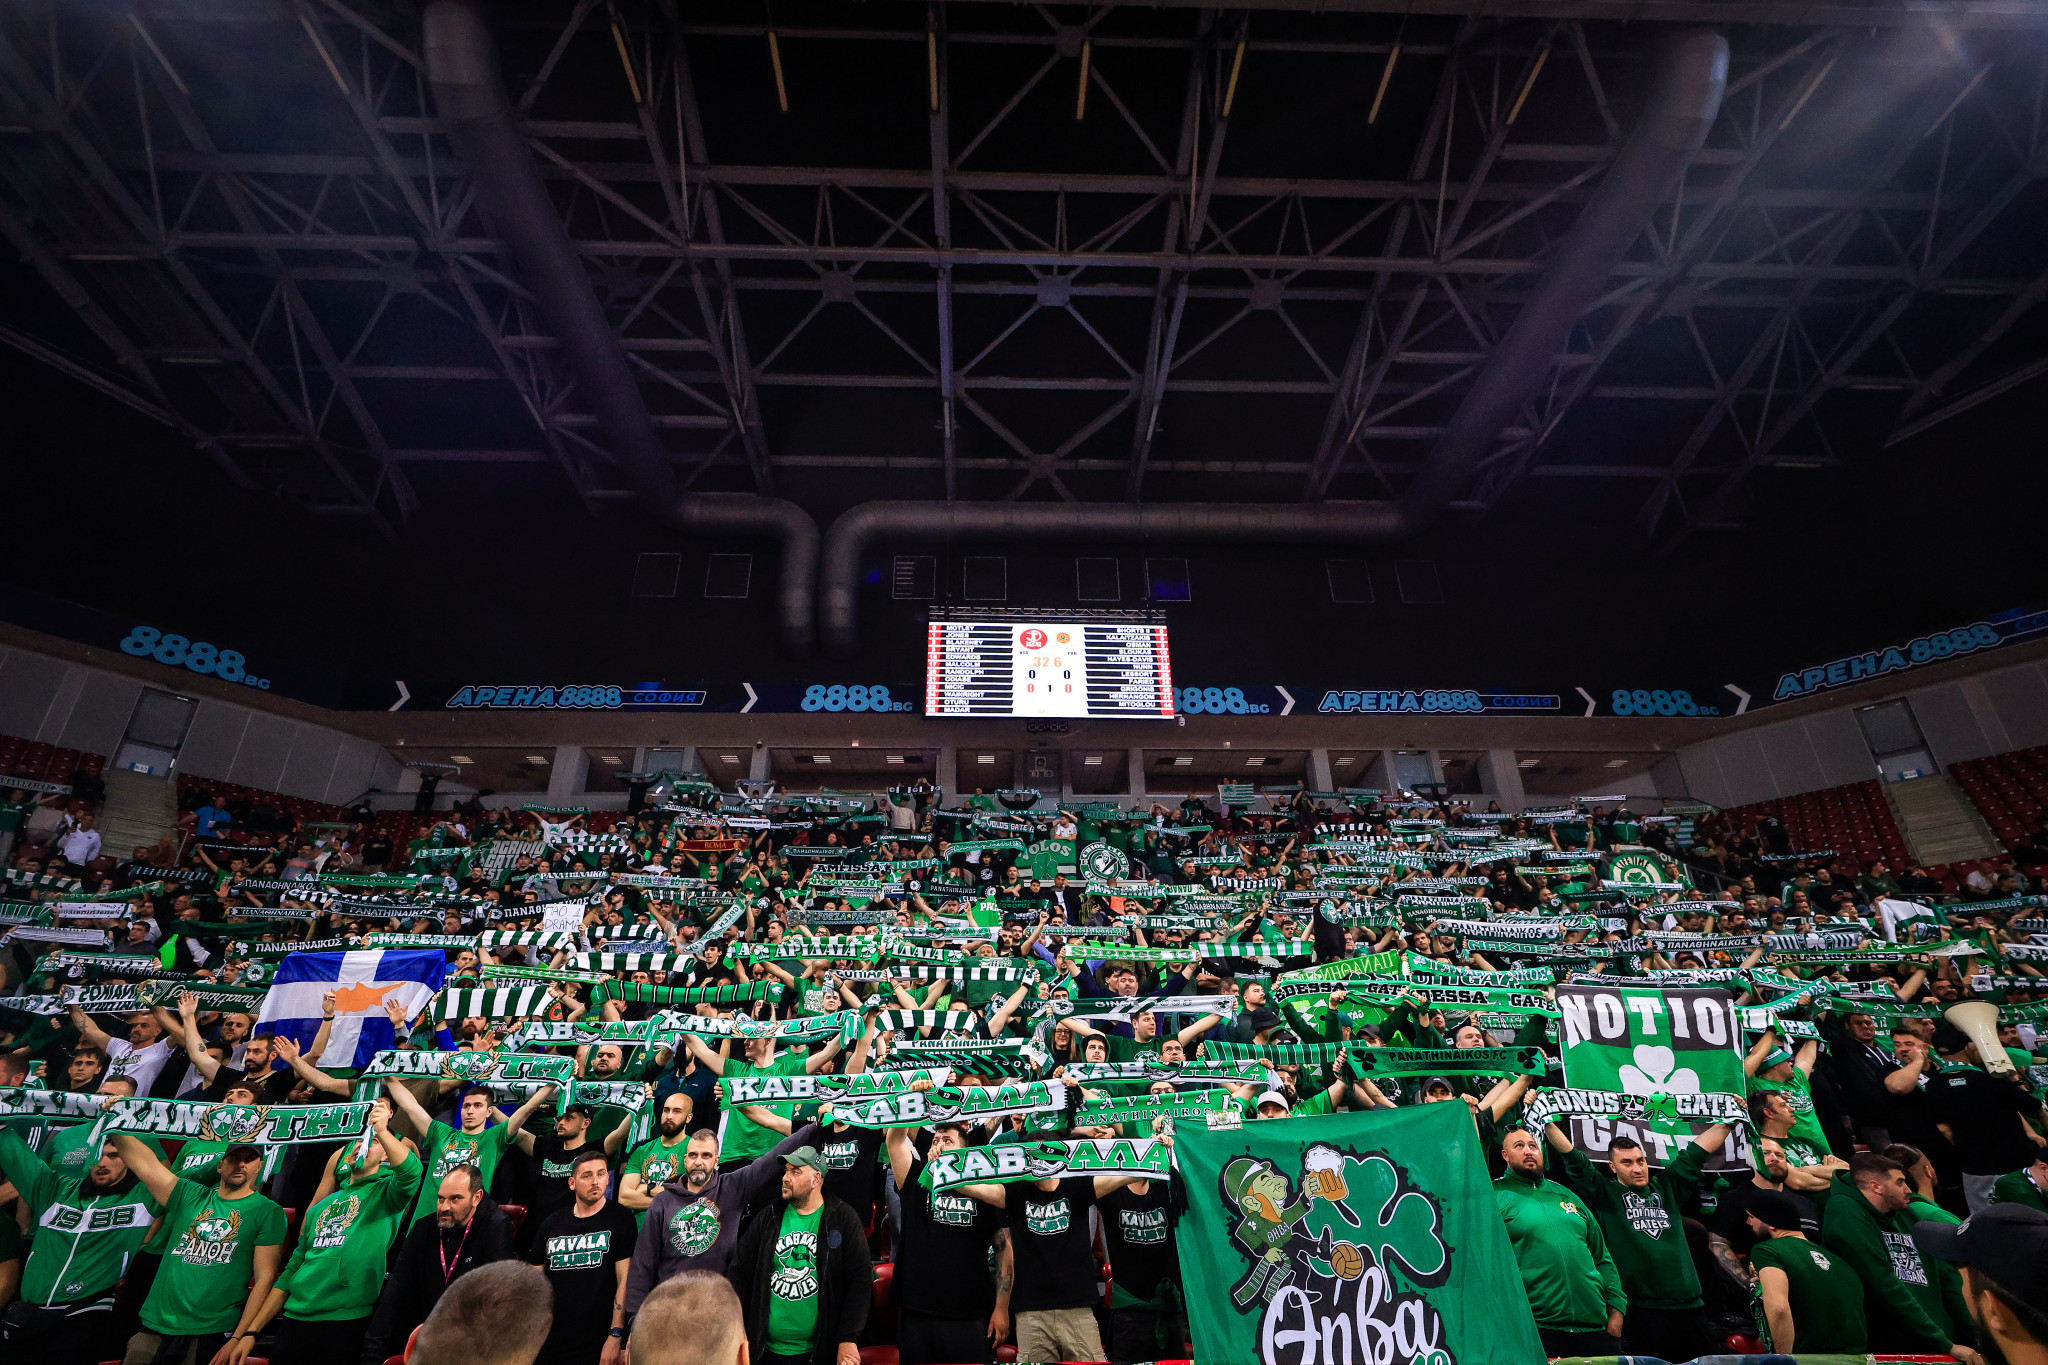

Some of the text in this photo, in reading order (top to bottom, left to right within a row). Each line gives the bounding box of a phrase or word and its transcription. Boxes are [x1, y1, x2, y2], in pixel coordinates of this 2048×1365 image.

[120, 626, 271, 690] 8888.BG
[1778, 624, 1999, 697] АРЕНА 8888
[1029, 670, 1070, 679] 0 0
[450, 687, 697, 706] АРЕНА 8888 СОФИЯ
[1027, 684, 1034, 693] 0
[1065, 684, 1072, 693] 0
[801, 685, 912, 712] 8888.BG
[1321, 692, 1552, 710] АРЕНА 8888 СОФИЯ
[1612, 690, 1719, 716] 8888.BG
[704, 841, 727, 849] ROMA
[1082, 841, 1128, 865] CHIOS CLUB
[816, 864, 881, 872] AMFISSA
[931, 885, 976, 894] PANATHINAIKOS
[1952, 900, 2023, 913] PANATHINAIKOS
[544, 918, 581, 931] DRAMA
[1151, 918, 1211, 927] ΠΑΟ ΠΑΟ
[774, 943, 858, 958] ΑΡΙΔΑΙΑ
[884, 943, 944, 961] ΡΙΔΑΙΑ
[1467, 939, 1551, 955] NAXOS
[1275, 983, 1402, 1002] EDESSA GAT
[1510, 993, 1556, 1012] GATE
[1389, 1050, 1508, 1062] PANATHINAIKOS FC
[879, 1059, 973, 1071] PANATHINAIKOS
[730, 1077, 817, 1103] ΚΑΒ
[1676, 1094, 1744, 1118] GATE
[107, 1099, 201, 1135] XAN
[933, 1141, 1170, 1187] ΚΑΒ ΑΛΑ
[50, 1206, 136, 1230] 1988
[1026, 1201, 1070, 1218] KAVALA
[1028, 1219, 1061, 1232] CLUB
[1121, 1211, 1165, 1226] KAVALA
[548, 1232, 608, 1254] KAVALA
[1126, 1228, 1157, 1241] CLUB
[551, 1252, 591, 1267] CLUB
[802, 1277, 817, 1295] 13
